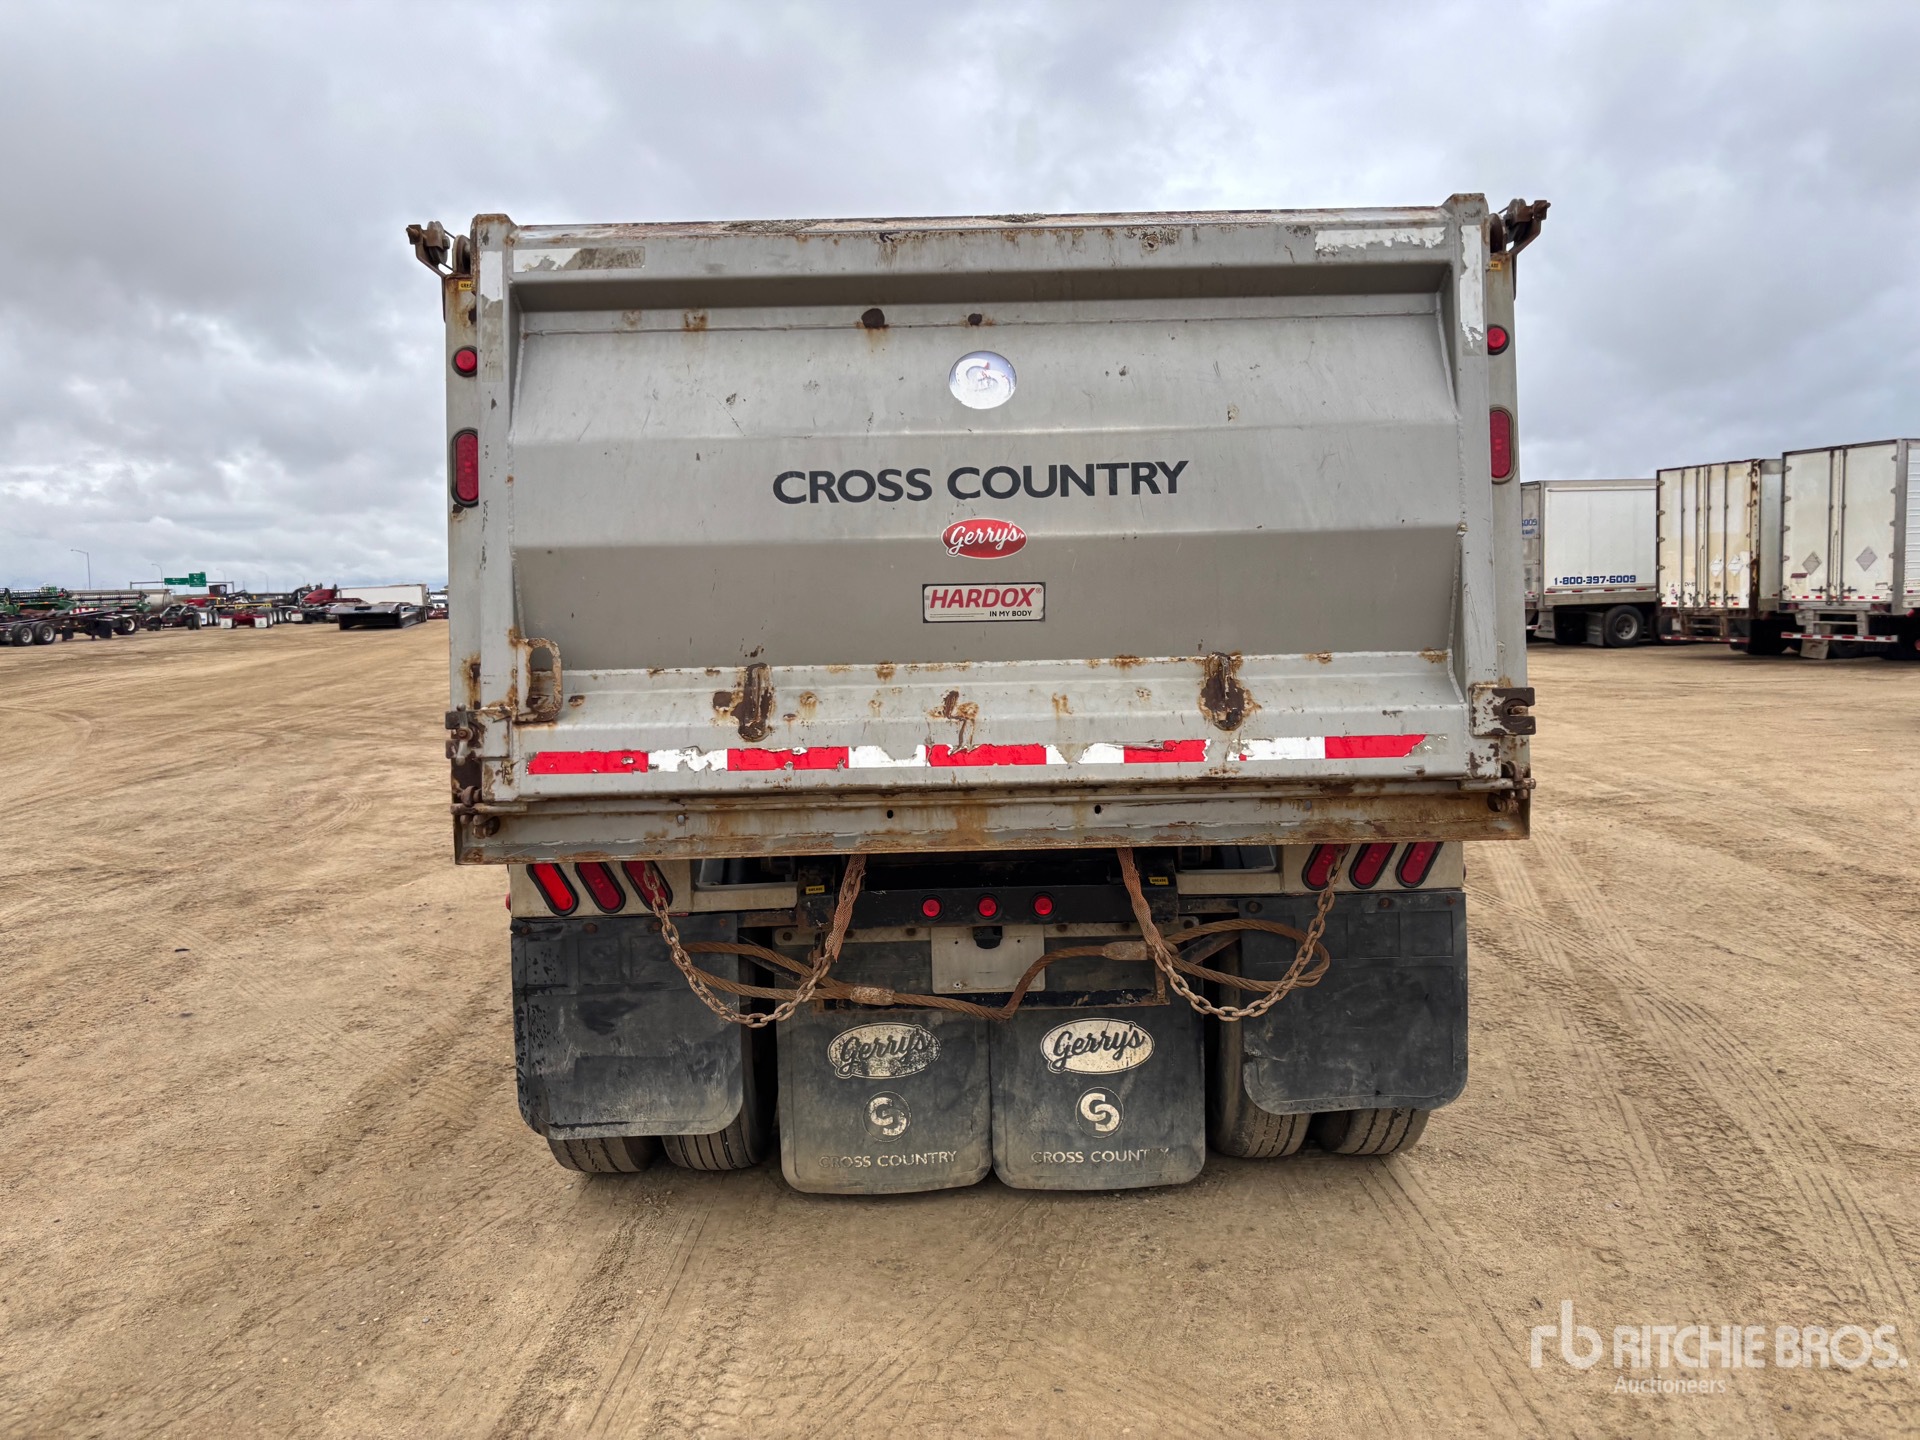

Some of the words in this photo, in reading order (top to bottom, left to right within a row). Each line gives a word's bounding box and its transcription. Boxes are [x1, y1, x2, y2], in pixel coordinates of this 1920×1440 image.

[773, 468, 932, 504] CROSS
[947, 460, 1189, 499] COUNTRY
[948, 523, 1021, 555] Gerry's
[1554, 575, 1636, 585] 1-800-397-6009
[840, 1027, 932, 1075] Gerry's
[1051, 1023, 1146, 1069] Gerry's
[818, 1155, 871, 1168] CROSS
[877, 1151, 957, 1167] COUNTRY
[1031, 1151, 1085, 1164] CROSS
[1090, 1147, 1170, 1163] COUNTY
